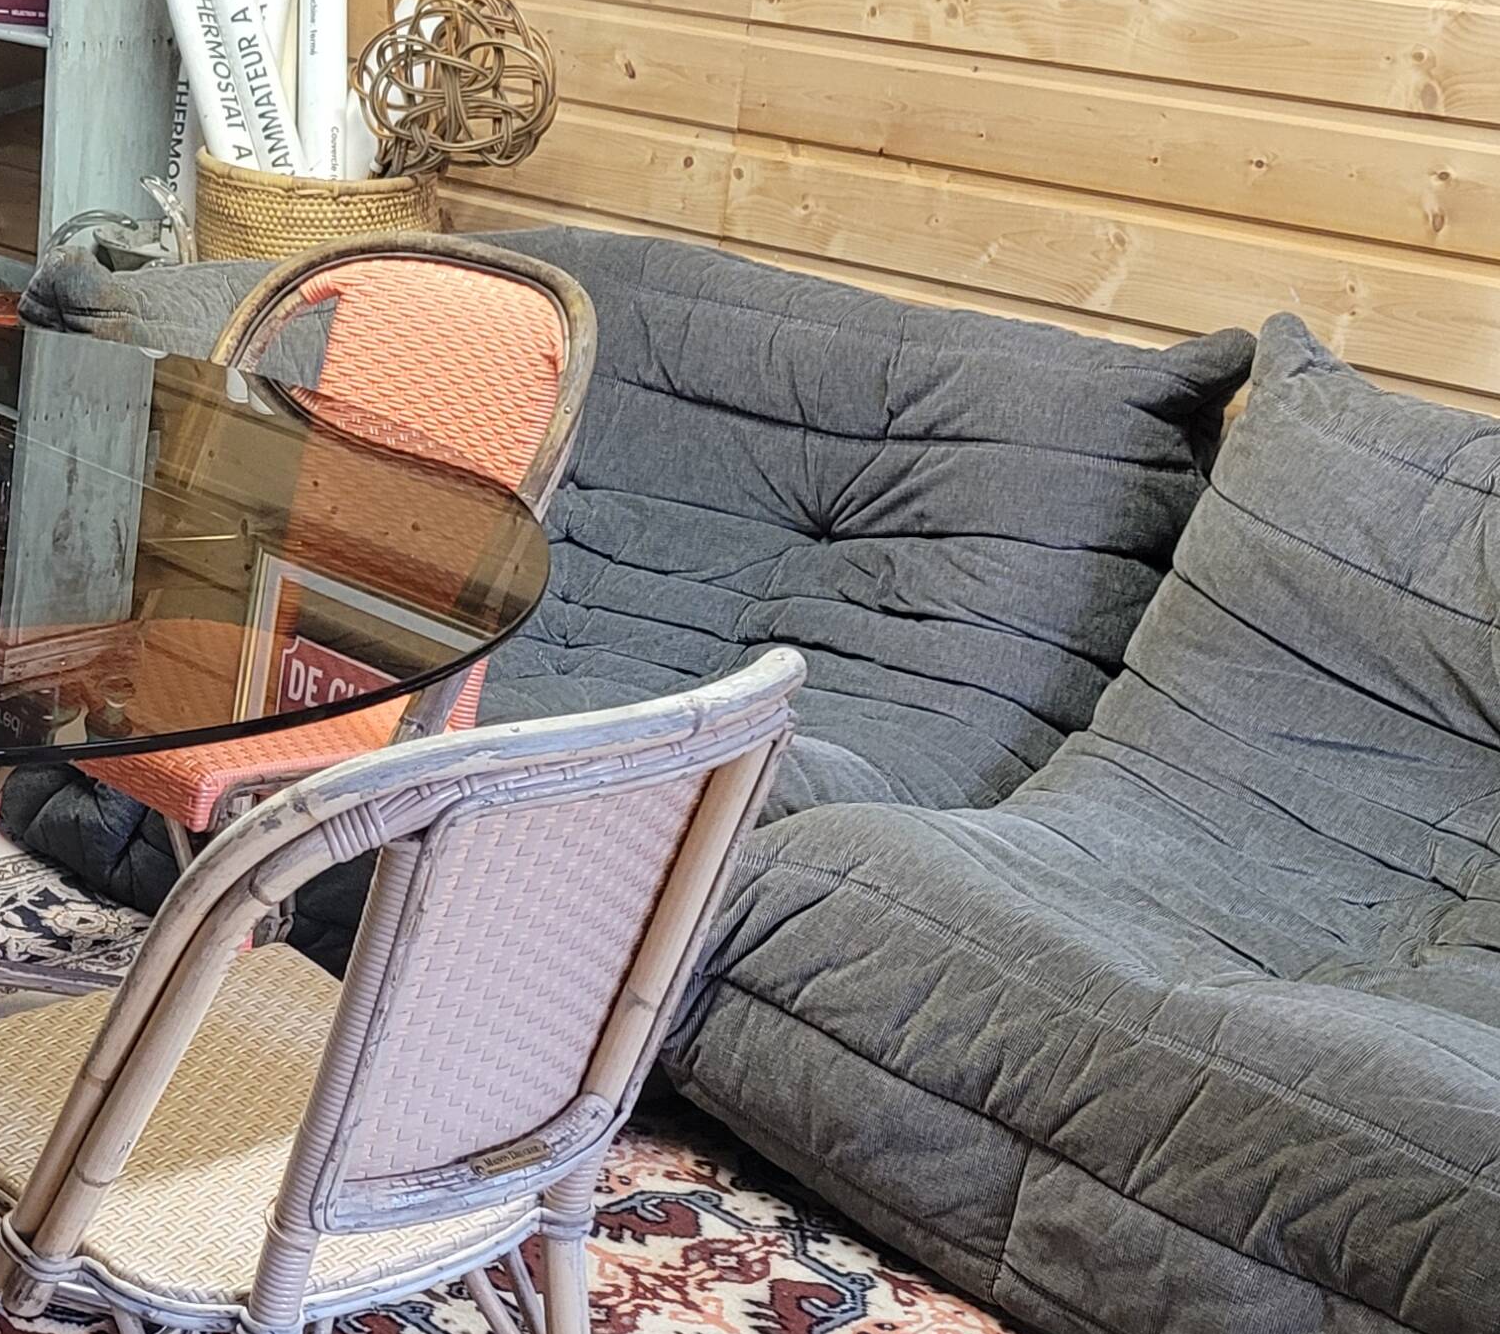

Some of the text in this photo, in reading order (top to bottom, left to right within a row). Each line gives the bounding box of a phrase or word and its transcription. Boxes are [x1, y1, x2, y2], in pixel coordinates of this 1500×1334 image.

[231, 7, 253, 23] A
[238, 33, 295, 175] AMMATEUR
[232, 144, 253, 161] A
[331, 126, 340, 172] Couvercle
